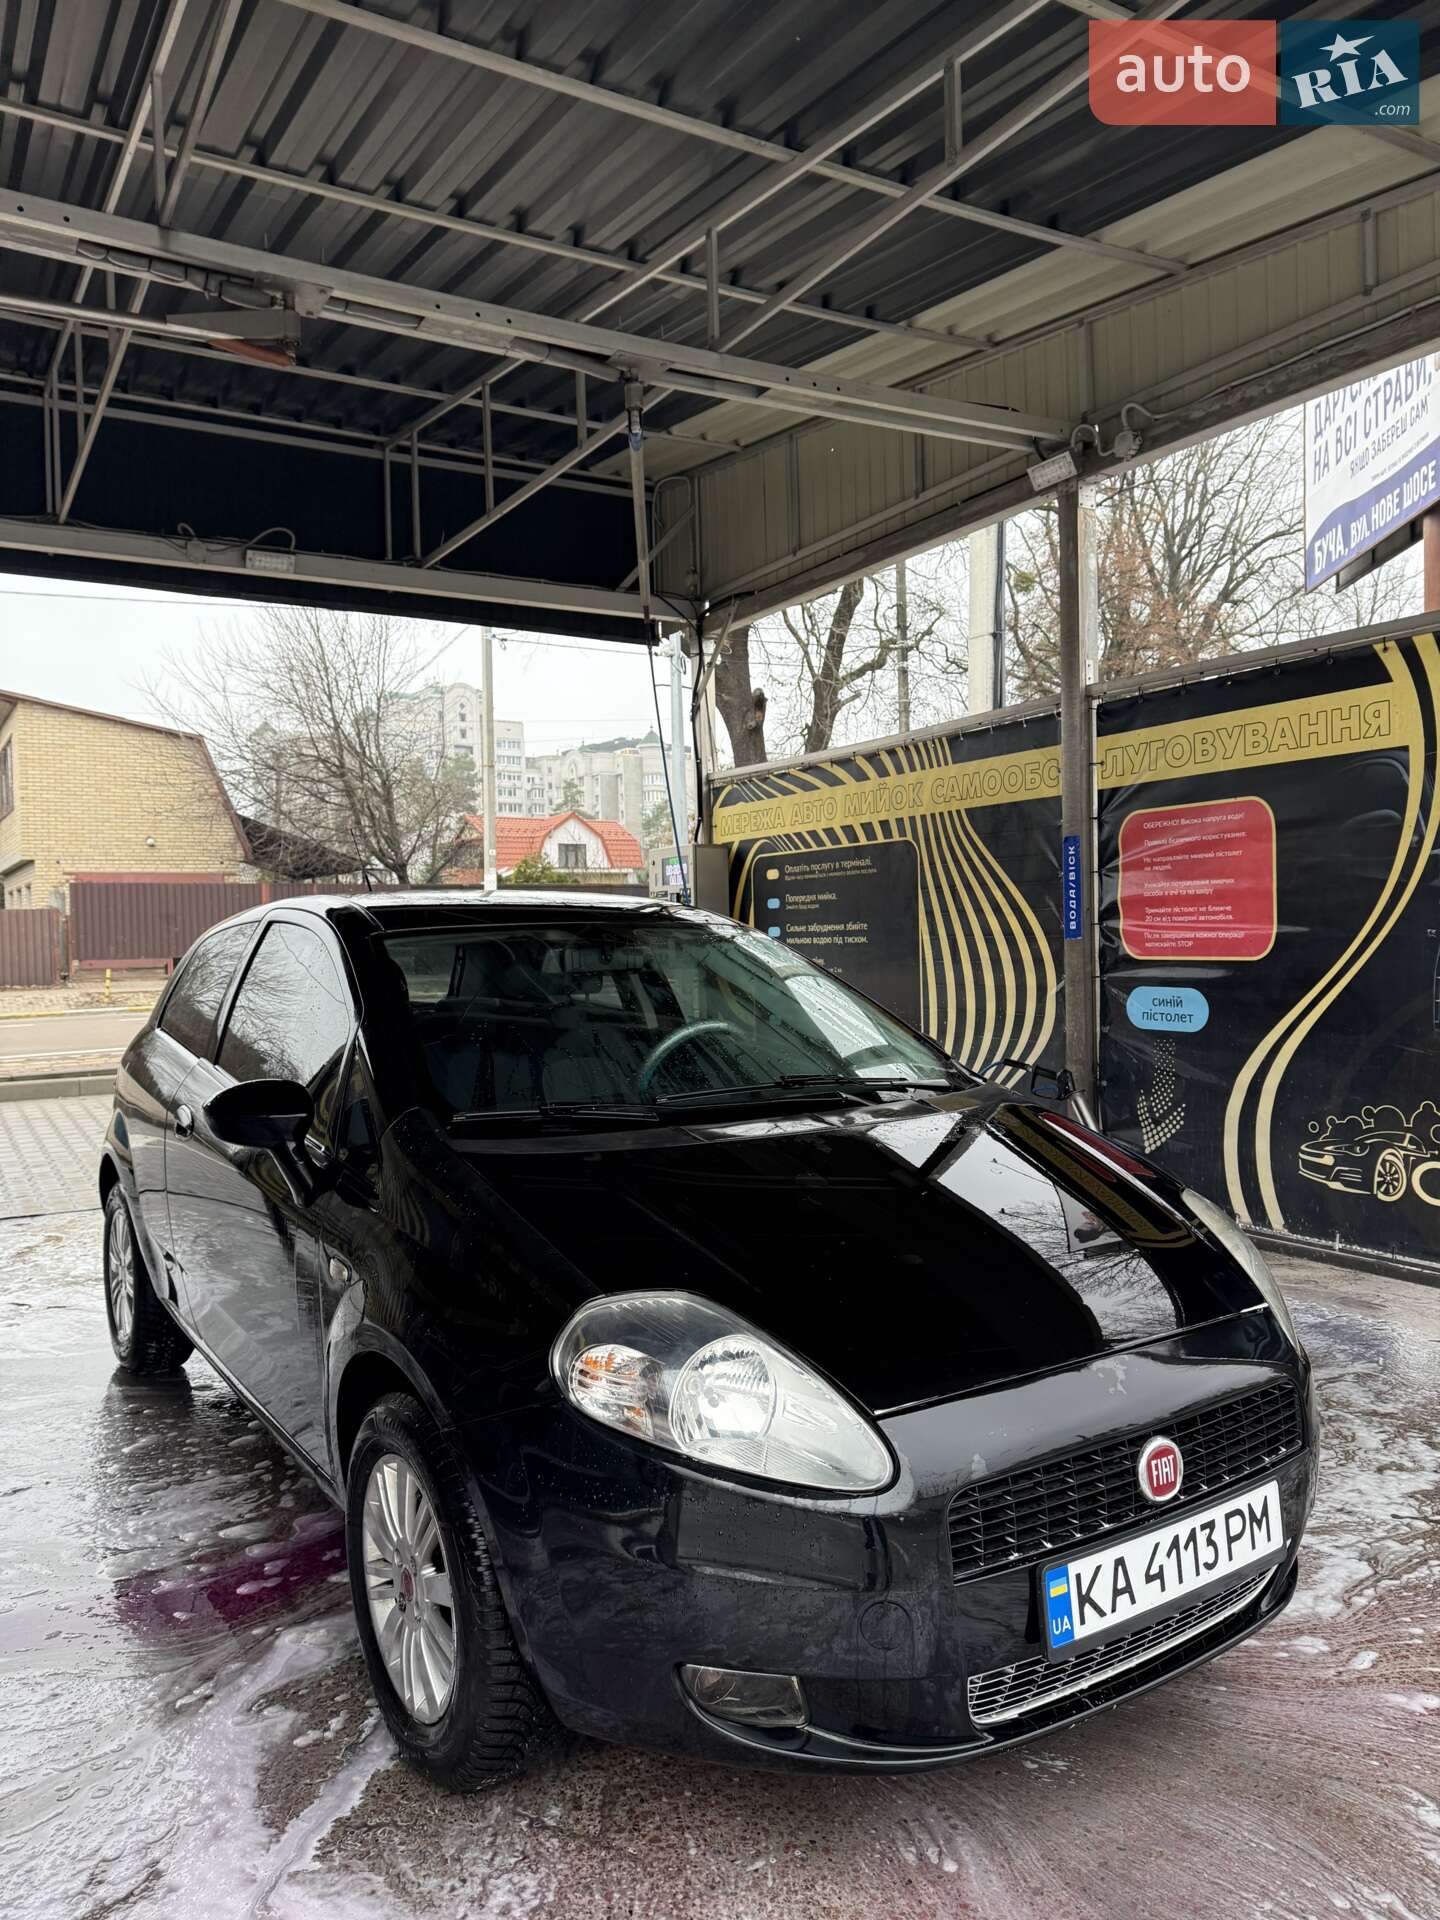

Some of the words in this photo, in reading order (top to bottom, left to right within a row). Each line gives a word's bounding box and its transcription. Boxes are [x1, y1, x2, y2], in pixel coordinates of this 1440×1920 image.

[1313, 439, 1330, 485] НА
[1335, 410, 1357, 467] ВСІ
[1363, 357, 1432, 440] СТРАВИ,
[1314, 523, 1348, 575] БУЧА,
[1350, 514, 1370, 549] ВУЛ.
[1371, 487, 1400, 531] НОВЕ
[1403, 460, 1437, 509] ШОСЕ
[720, 808, 786, 837] МЕРЕЖА
[790, 800, 838, 826] АВТО
[843, 780, 924, 818] МИЙОК
[1068, 844, 1077, 930] ВОДА/ВІСК
[1141, 1010, 1195, 1026] пістолет
[1151, 995, 1184, 1009] синій
[1151, 1454, 1176, 1488] FIAT
[1075, 1556, 1137, 1626] KA
[1144, 1518, 1220, 1593] 4113
[1224, 1494, 1272, 1563] PM
[1052, 1616, 1072, 1636] UA
